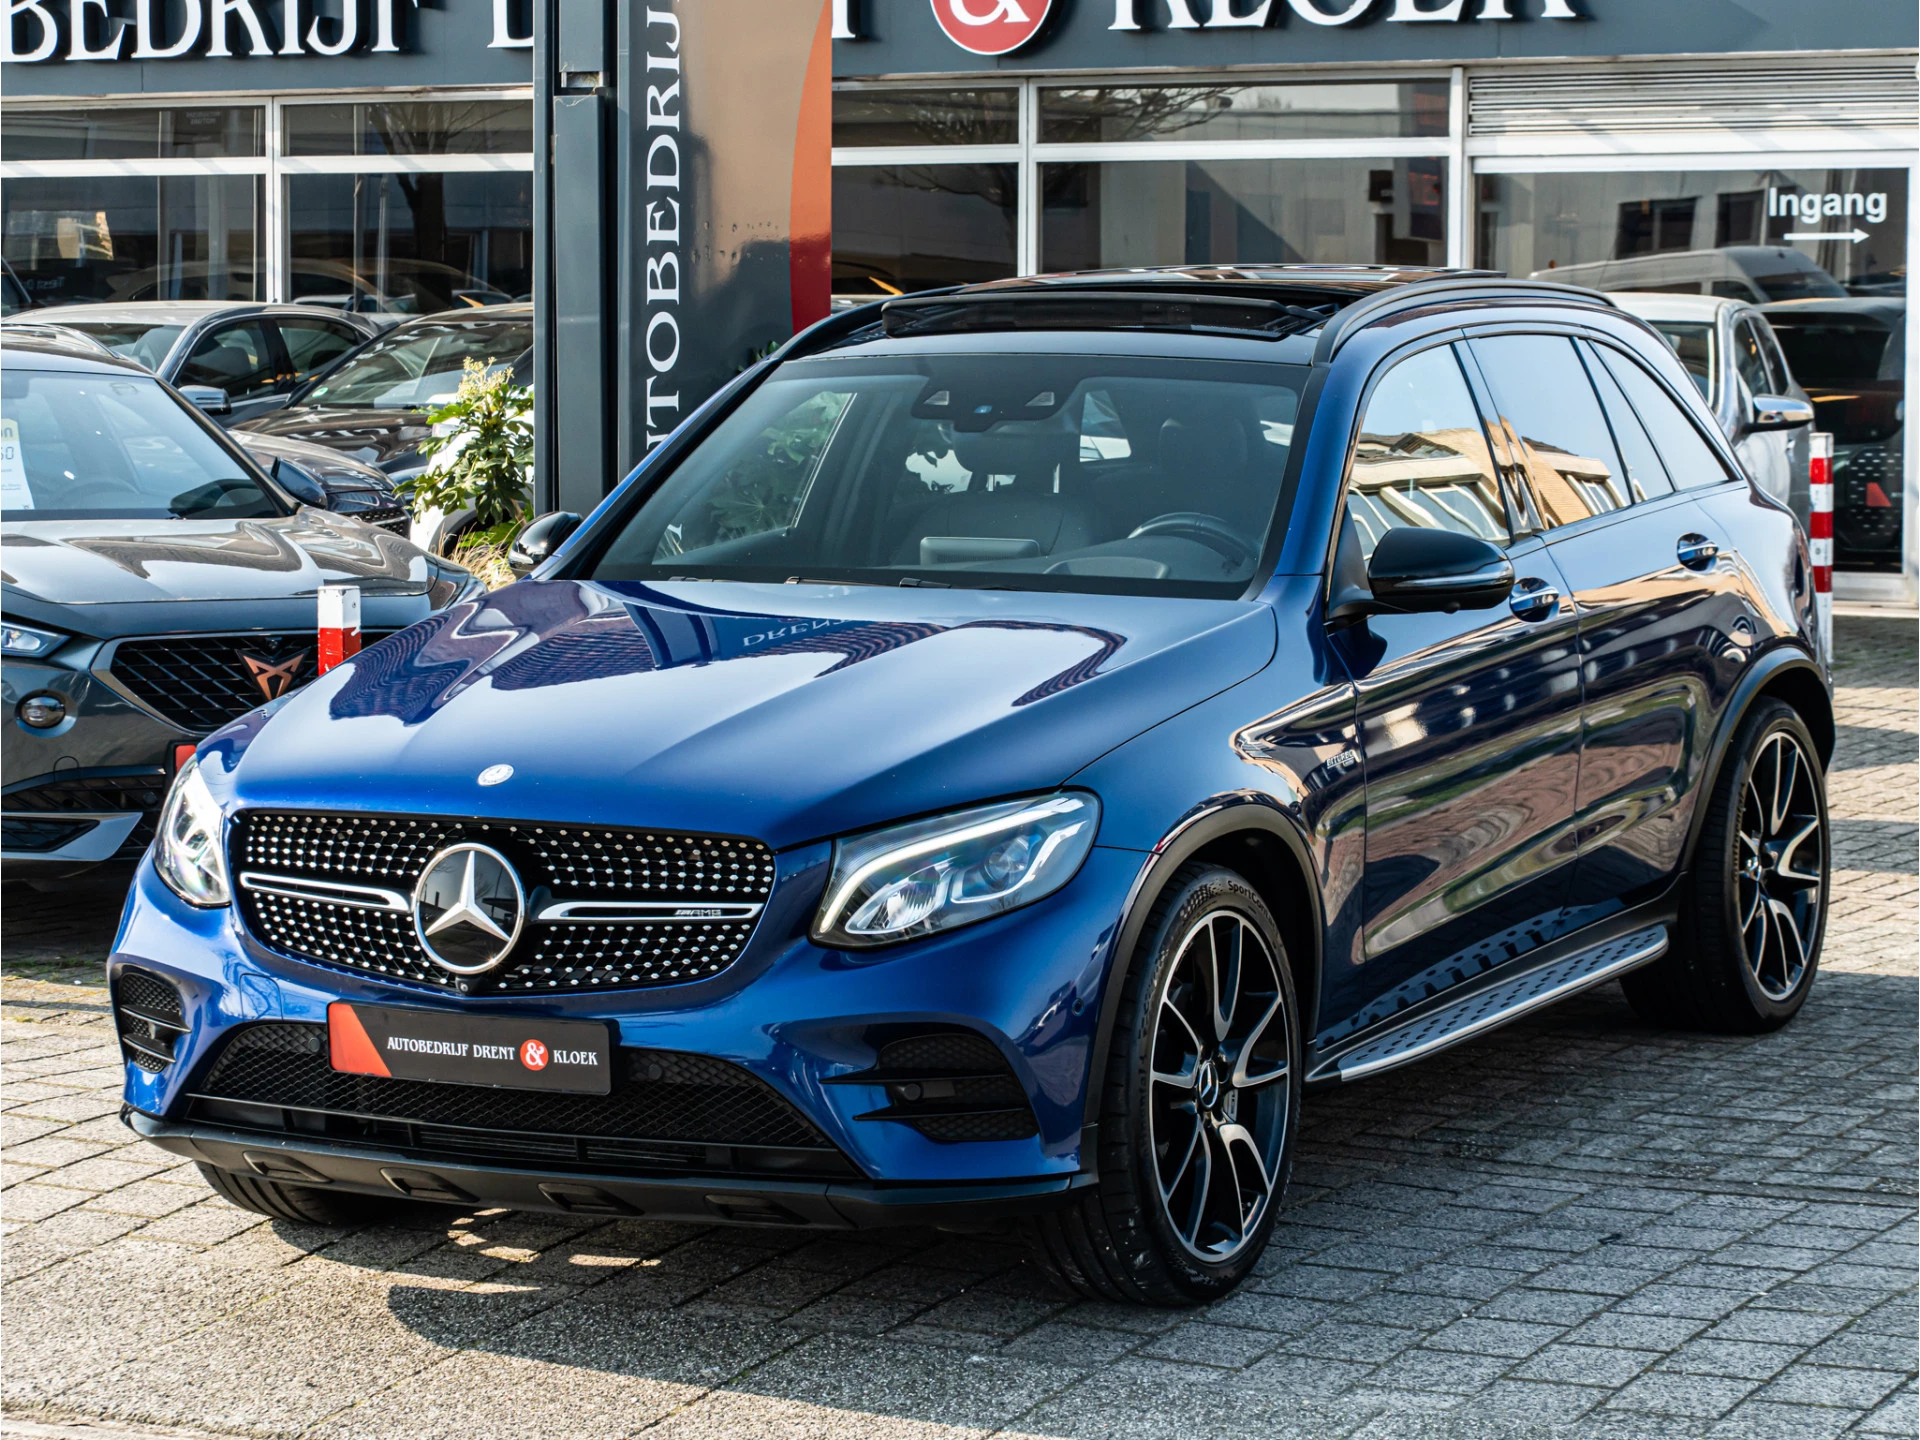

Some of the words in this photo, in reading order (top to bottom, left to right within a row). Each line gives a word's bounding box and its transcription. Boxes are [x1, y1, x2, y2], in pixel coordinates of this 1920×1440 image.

[1769, 187, 1887, 224] Ingang
[387, 1036, 469, 1057] AUTOBEDRIJF
[473, 1044, 515, 1061] DRENT
[524, 1042, 545, 1067] &
[553, 1050, 598, 1066] KLOEK
